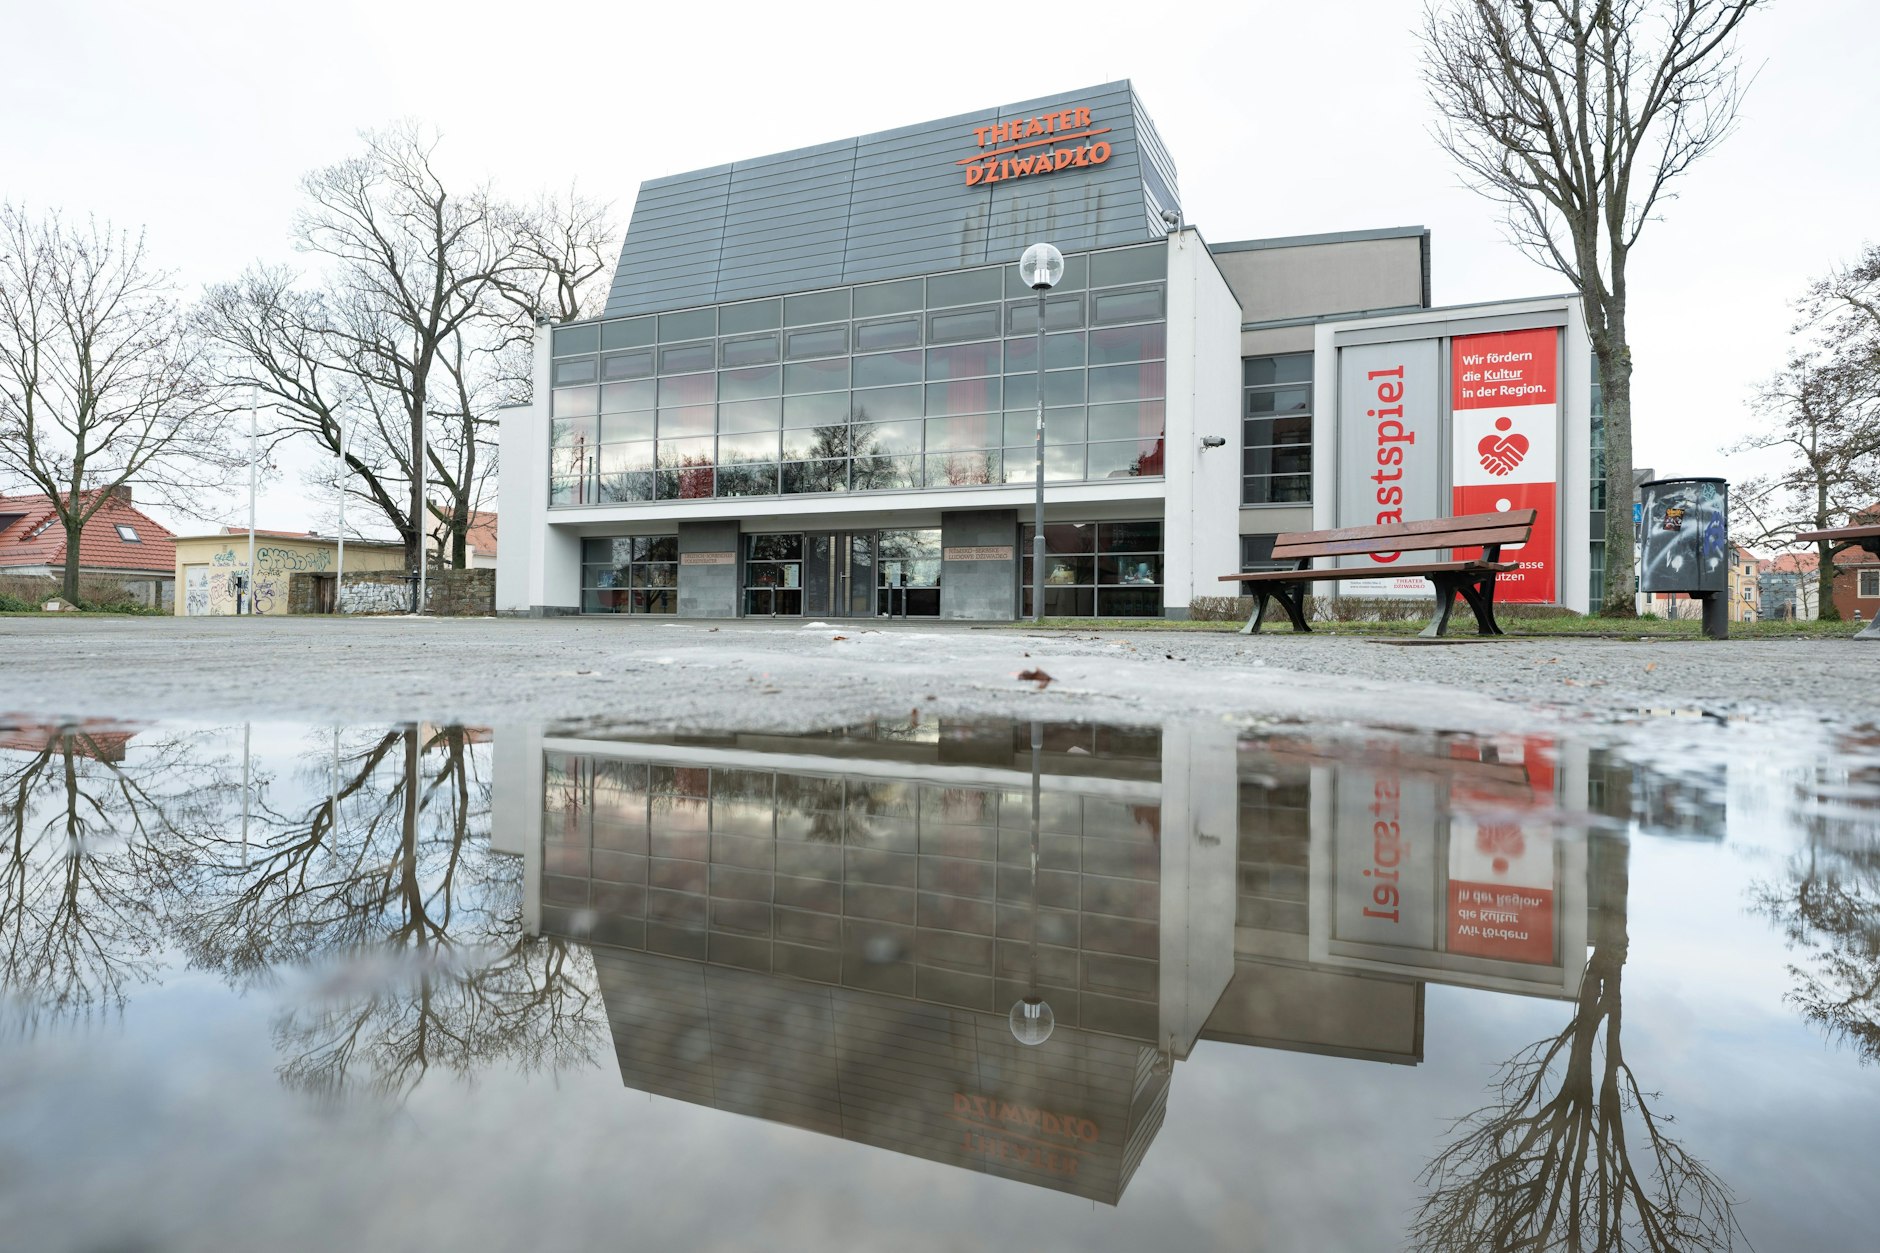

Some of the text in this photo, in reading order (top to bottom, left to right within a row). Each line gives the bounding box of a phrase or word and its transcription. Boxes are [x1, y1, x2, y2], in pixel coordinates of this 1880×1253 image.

[973, 107, 1092, 147] THEATER
[966, 141, 1112, 186] DŹIWADŁO
[1462, 351, 1533, 366] Wir fördern
[1462, 369, 1523, 382] die Kultur
[1462, 383, 1546, 398] in der Region.
[1495, 573, 1525, 582] utzen
